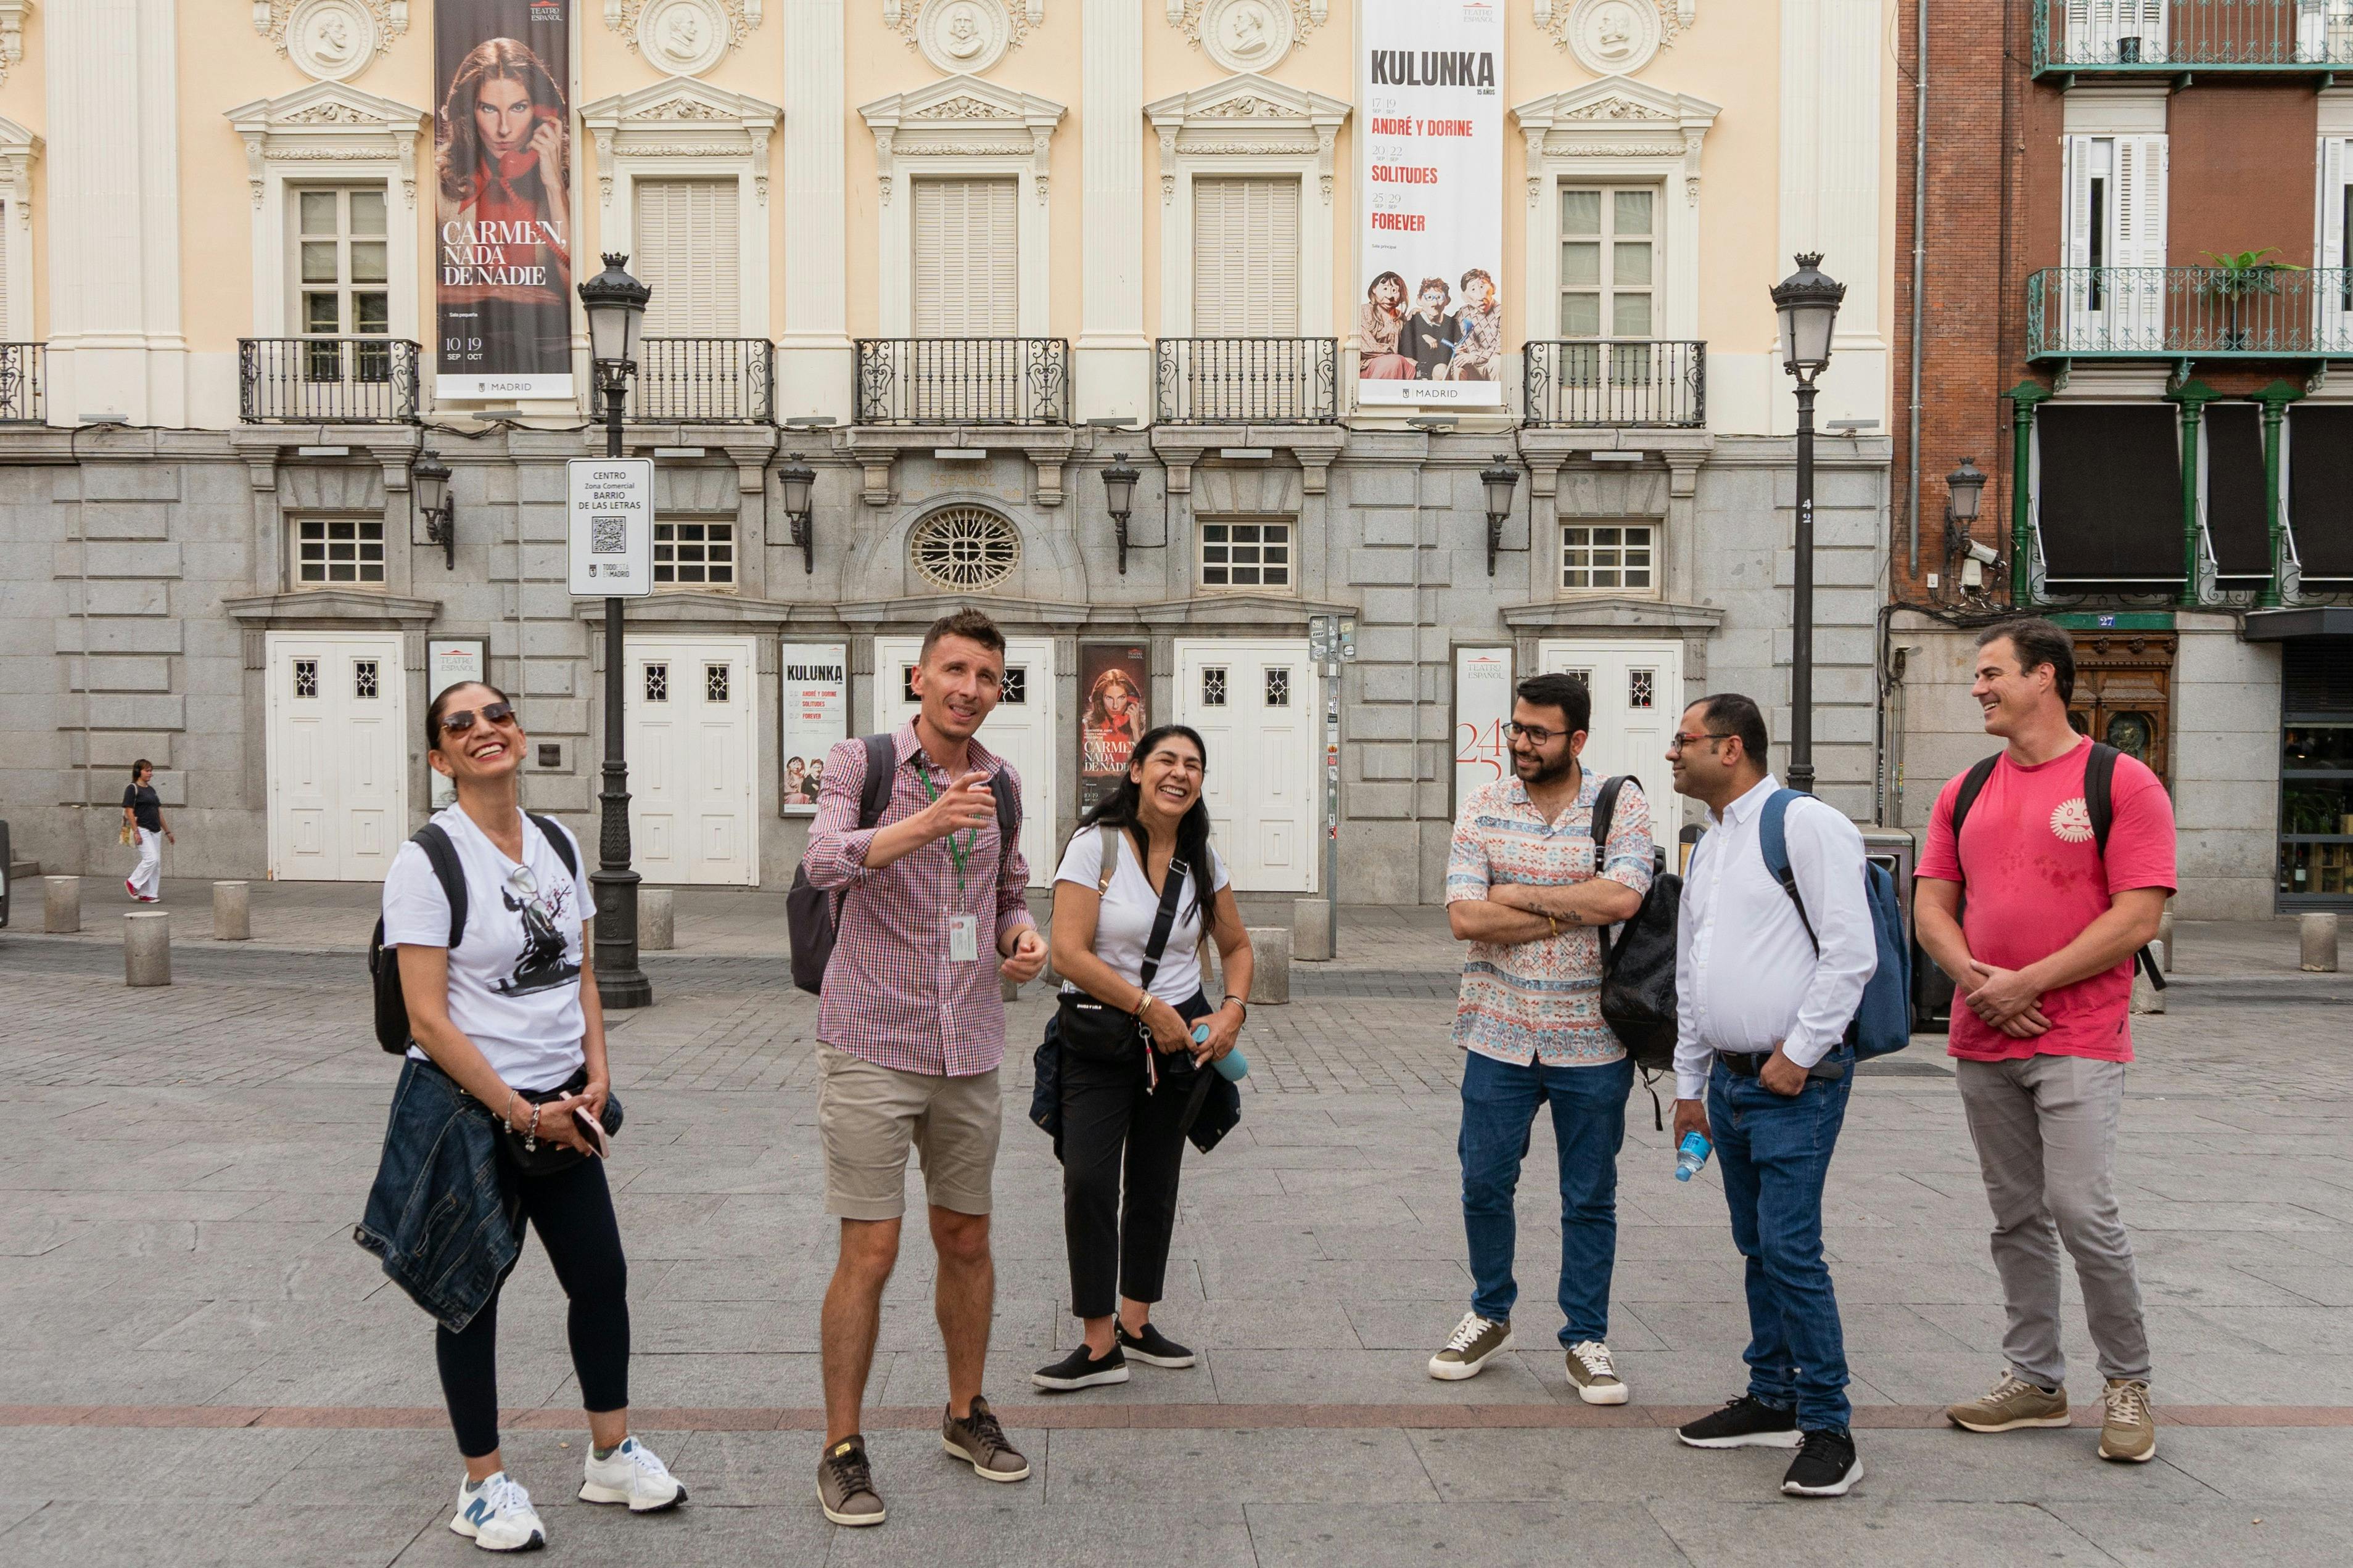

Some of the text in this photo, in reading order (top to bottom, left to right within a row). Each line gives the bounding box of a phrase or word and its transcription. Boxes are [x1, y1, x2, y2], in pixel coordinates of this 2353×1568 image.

[1464, 15, 1496, 23] ESPAÑOL
[1372, 50, 1494, 86] KULUNKA
[1372, 98, 1396, 109] 17 19
[1372, 115, 1473, 137] ANDRÉ Y DORINE
[1372, 146, 1403, 156] 20 22
[1372, 165, 1438, 184] SOLITUDES
[1372, 192, 1401, 203] 25 29
[1372, 212, 1425, 231] FOREVER
[443, 221, 566, 248] CARMEN,
[443, 245, 506, 265] NADA
[443, 266, 546, 286] DE NADIE
[445, 337, 482, 351] 10 19
[491, 383, 532, 392] MADRID
[1416, 389, 1458, 398] MADRID
[593, 472, 626, 480] CENTRO
[593, 491, 625, 499] BARRIO
[592, 501, 607, 509] LAS
[610, 501, 641, 509] LETRAS
[2100, 616, 2114, 626] 27
[440, 657, 474, 665] TEATRO
[441, 664, 477, 672] ESPAÑOL
[787, 665, 843, 681] KULUNKA
[1467, 664, 1501, 672] TEATRO
[1468, 671, 1505, 679] ESPAÑOL
[1456, 717, 1507, 763] 24
[1084, 752, 1115, 762] NADA
[1084, 762, 1098, 772] DE
